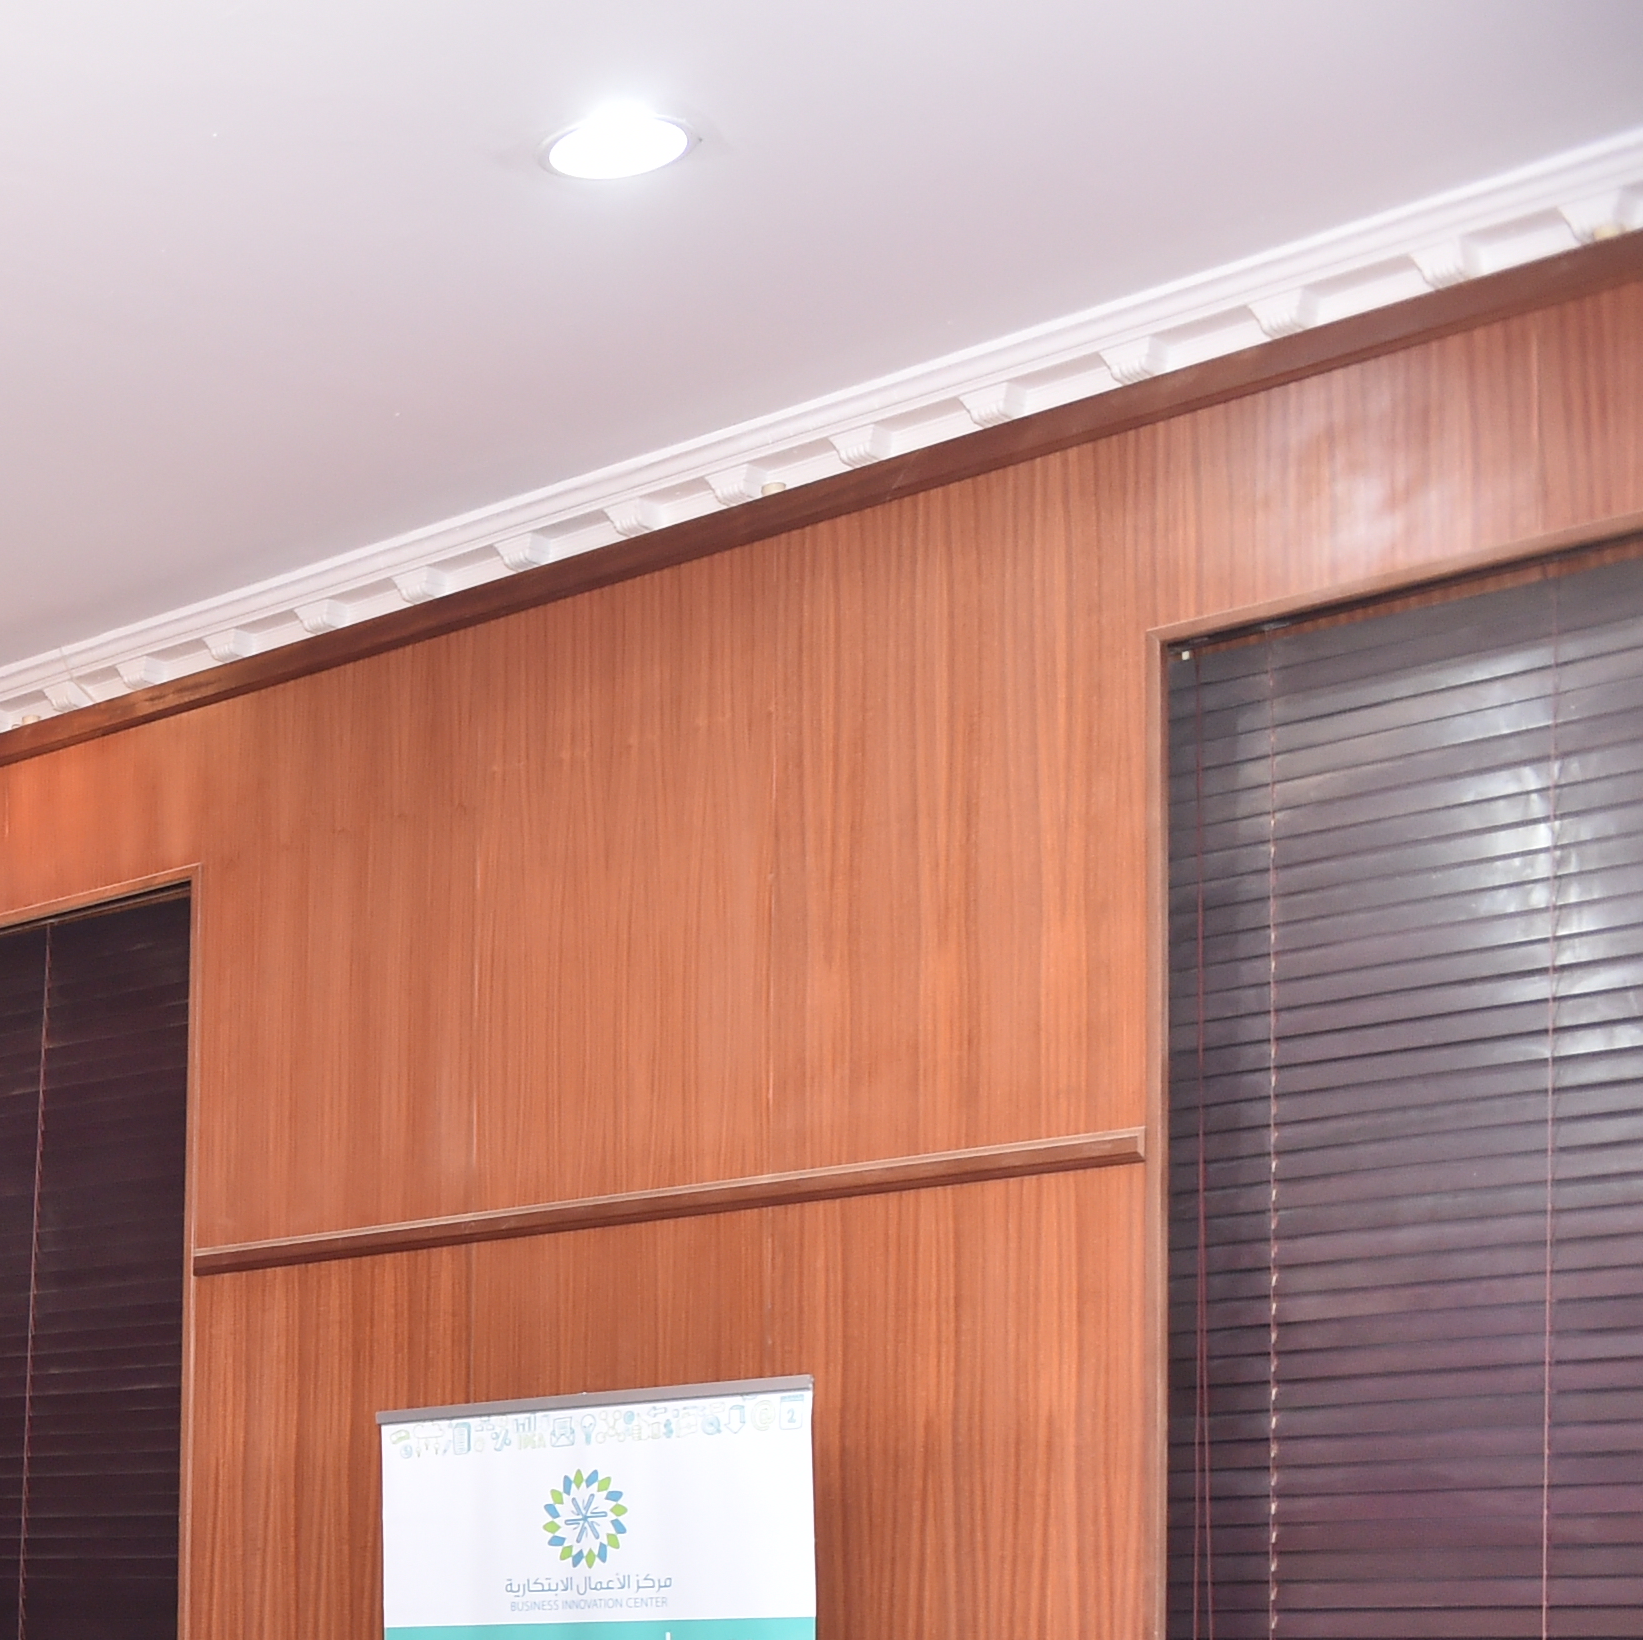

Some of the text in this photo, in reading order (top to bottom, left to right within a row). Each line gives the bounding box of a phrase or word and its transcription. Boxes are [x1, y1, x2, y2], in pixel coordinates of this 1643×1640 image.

[504, 1573, 673, 1598] مركز الأعمال الابتكارية
[510, 1596, 668, 1612] BUSINESS INNOVATION CENTER
